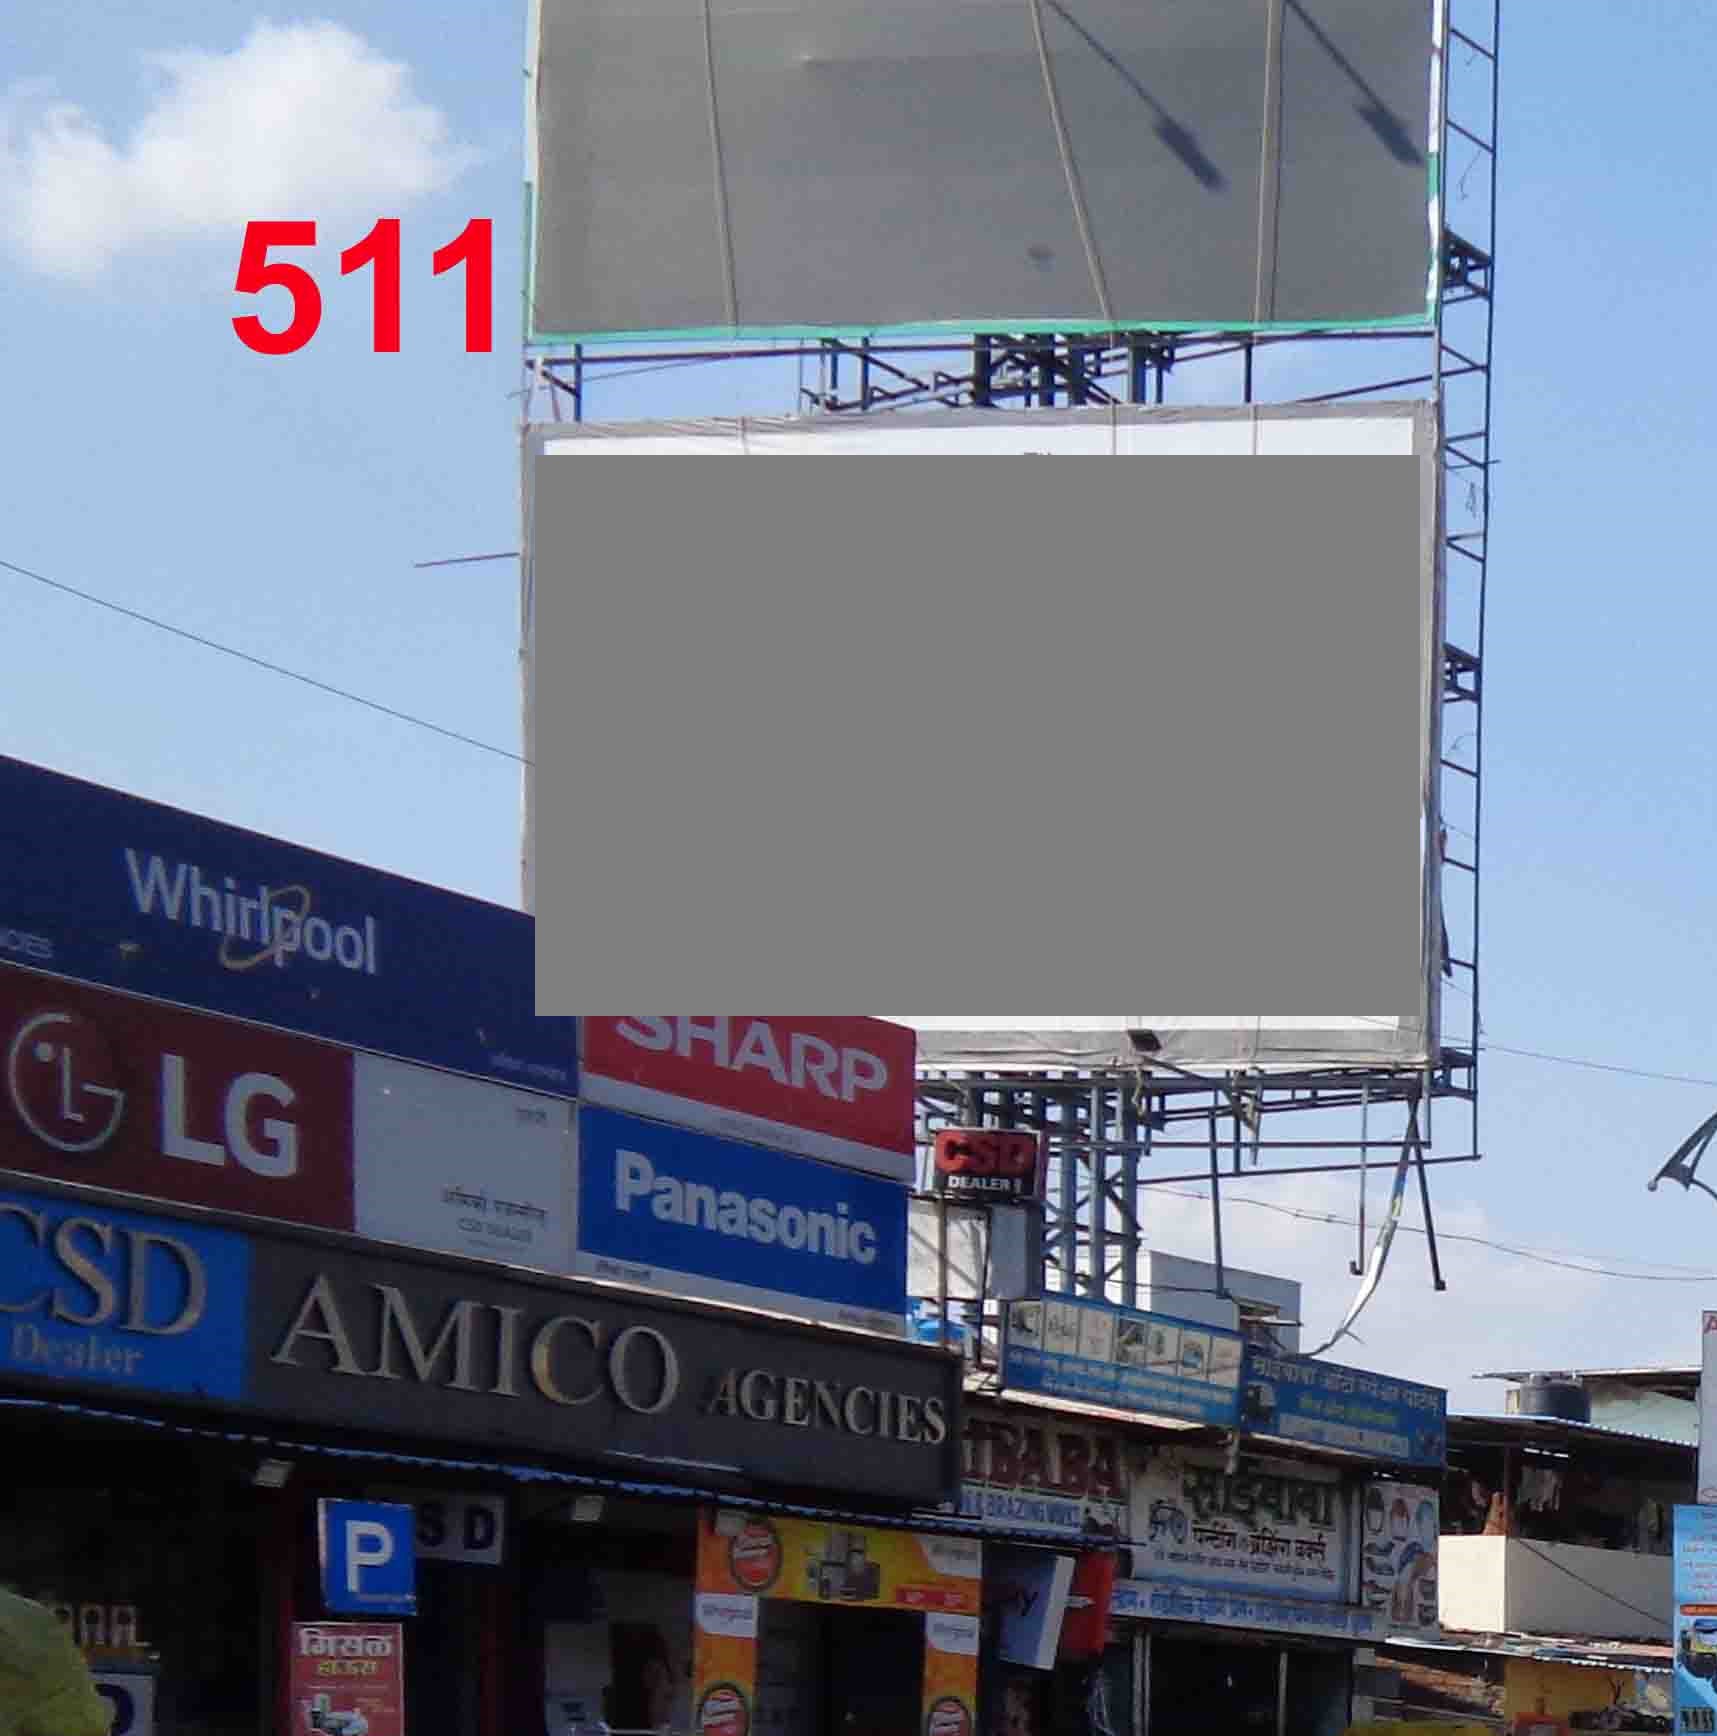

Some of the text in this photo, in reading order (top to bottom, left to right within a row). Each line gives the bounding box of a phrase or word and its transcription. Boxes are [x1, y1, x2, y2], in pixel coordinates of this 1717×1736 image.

[124, 848, 378, 975] Whirlpool
[615, 1016, 888, 1102] SHARP
[160, 1053, 299, 1179] LG
[614, 1148, 877, 1265] Panasonic
[948, 1175, 1010, 1192] DEALER
[10, 1322, 144, 1377] Dealer
[271, 1271, 681, 1414] AMICO
[706, 1366, 947, 1446] AGENCIES
[345, 1519, 394, 1593] P
